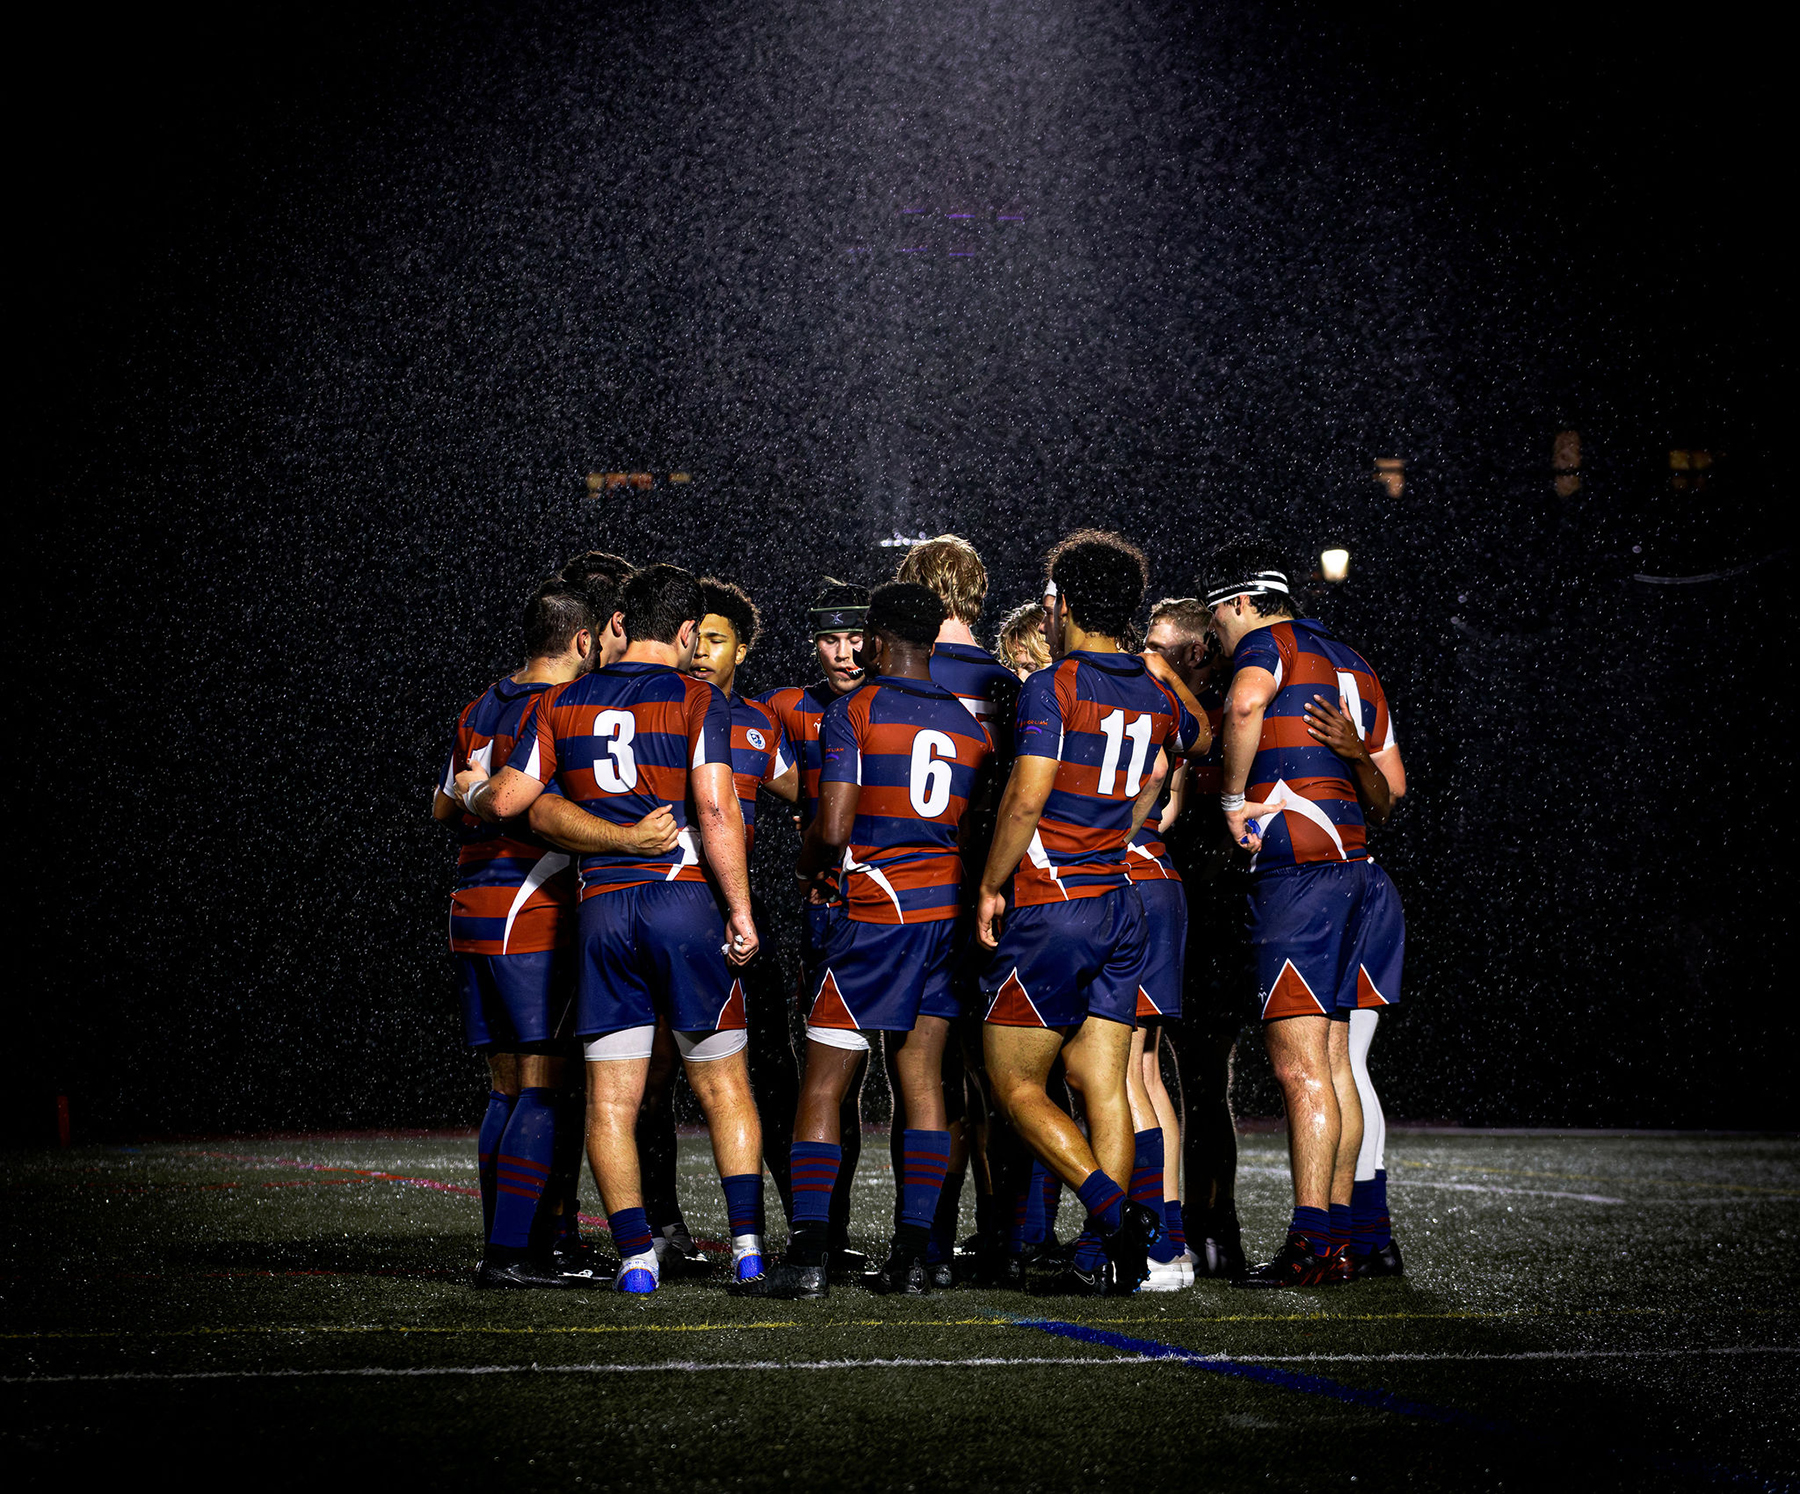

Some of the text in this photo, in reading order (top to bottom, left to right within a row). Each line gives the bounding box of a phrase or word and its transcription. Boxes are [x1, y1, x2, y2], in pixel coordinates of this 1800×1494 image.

[593, 709, 638, 794] 3
[909, 728, 957, 818] 6
[1097, 708, 1153, 798] 11
